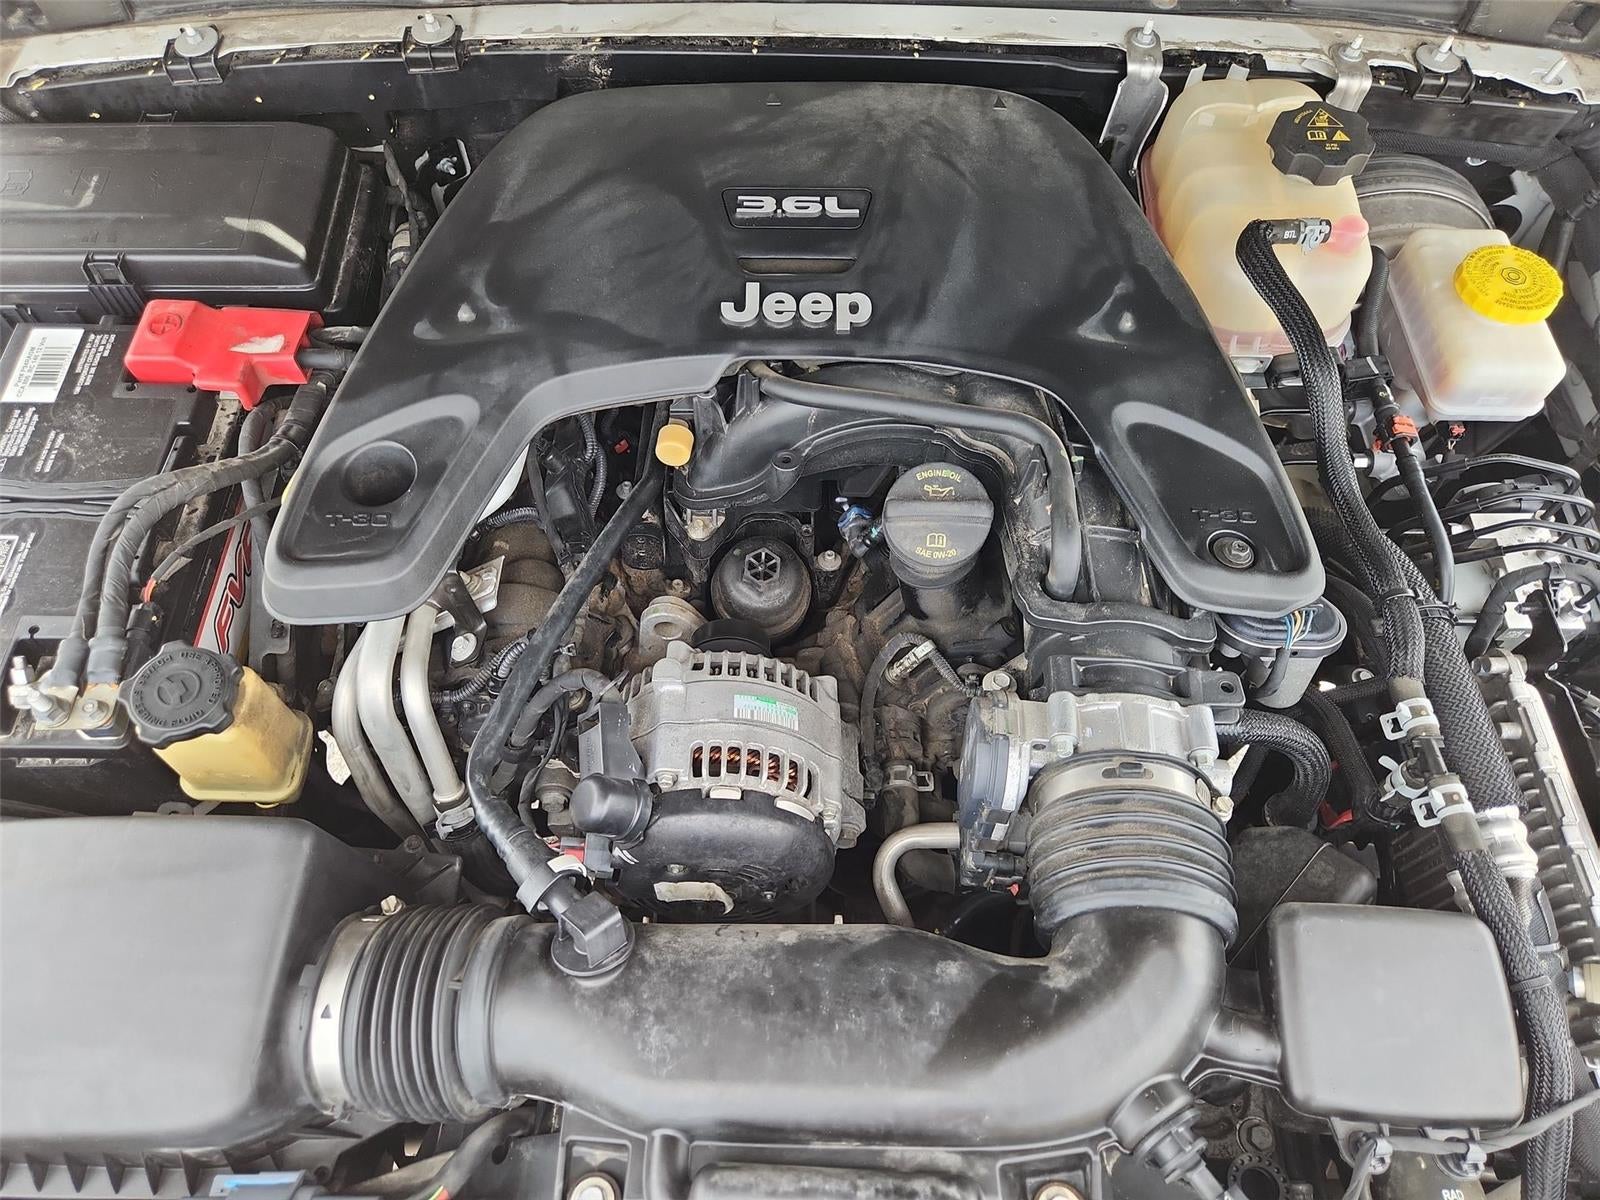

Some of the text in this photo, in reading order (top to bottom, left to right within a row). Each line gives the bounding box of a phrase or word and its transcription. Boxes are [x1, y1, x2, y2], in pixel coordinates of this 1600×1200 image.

[736, 195, 860, 218] 3.6L
[1283, 230, 1297, 239] BTL
[720, 281, 873, 334] Jeep
[915, 469, 962, 483] ENGINE OIL
[915, 546, 957, 559] SAE 0W-20
